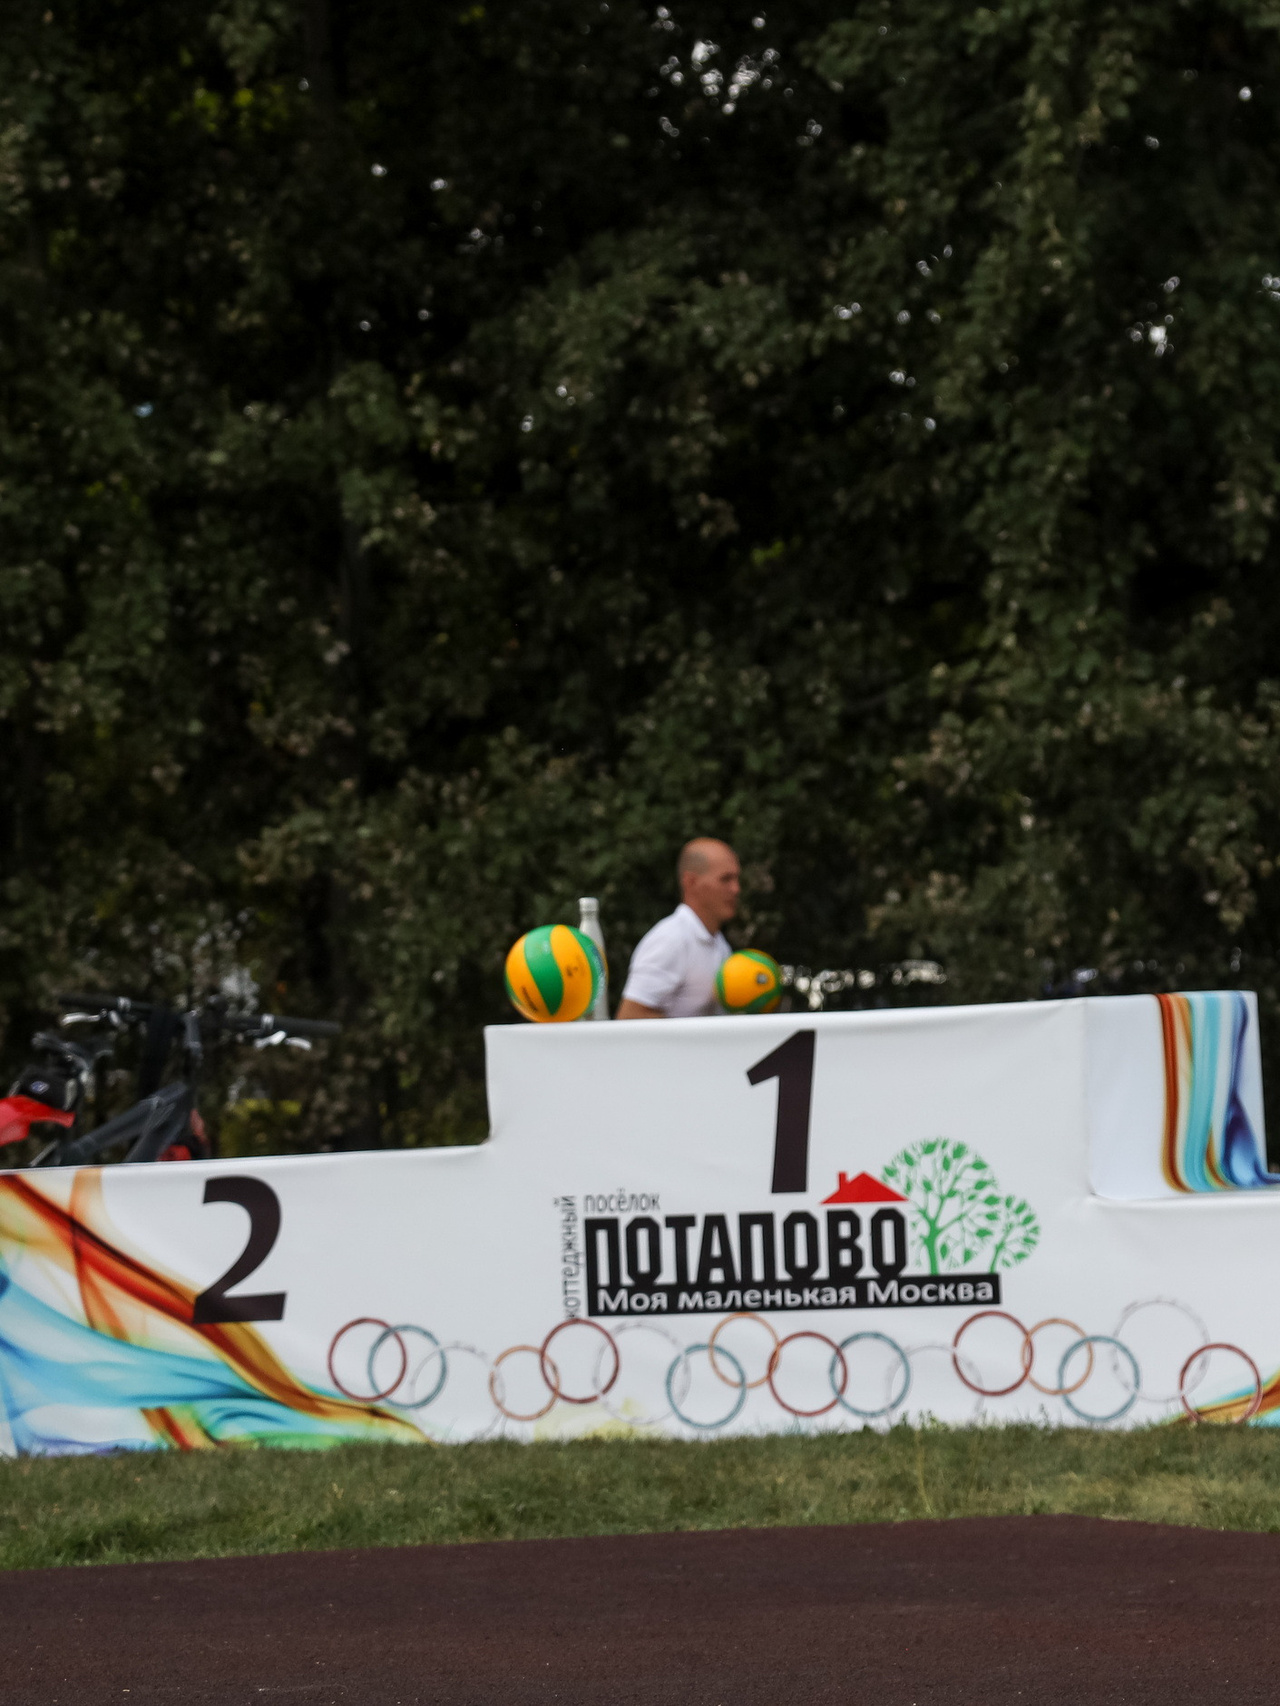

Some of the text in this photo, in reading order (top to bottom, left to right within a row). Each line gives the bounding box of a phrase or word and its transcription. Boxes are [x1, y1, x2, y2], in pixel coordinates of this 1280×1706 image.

[746, 1029, 816, 1193] 1
[193, 1174, 287, 1324] 2
[584, 1188, 660, 1213] посёлок
[584, 1208, 908, 1289] ПОТАПОВО
[554, 1195, 583, 1319] коттеджный
[597, 1279, 995, 1313] Моя маленькая Москва
